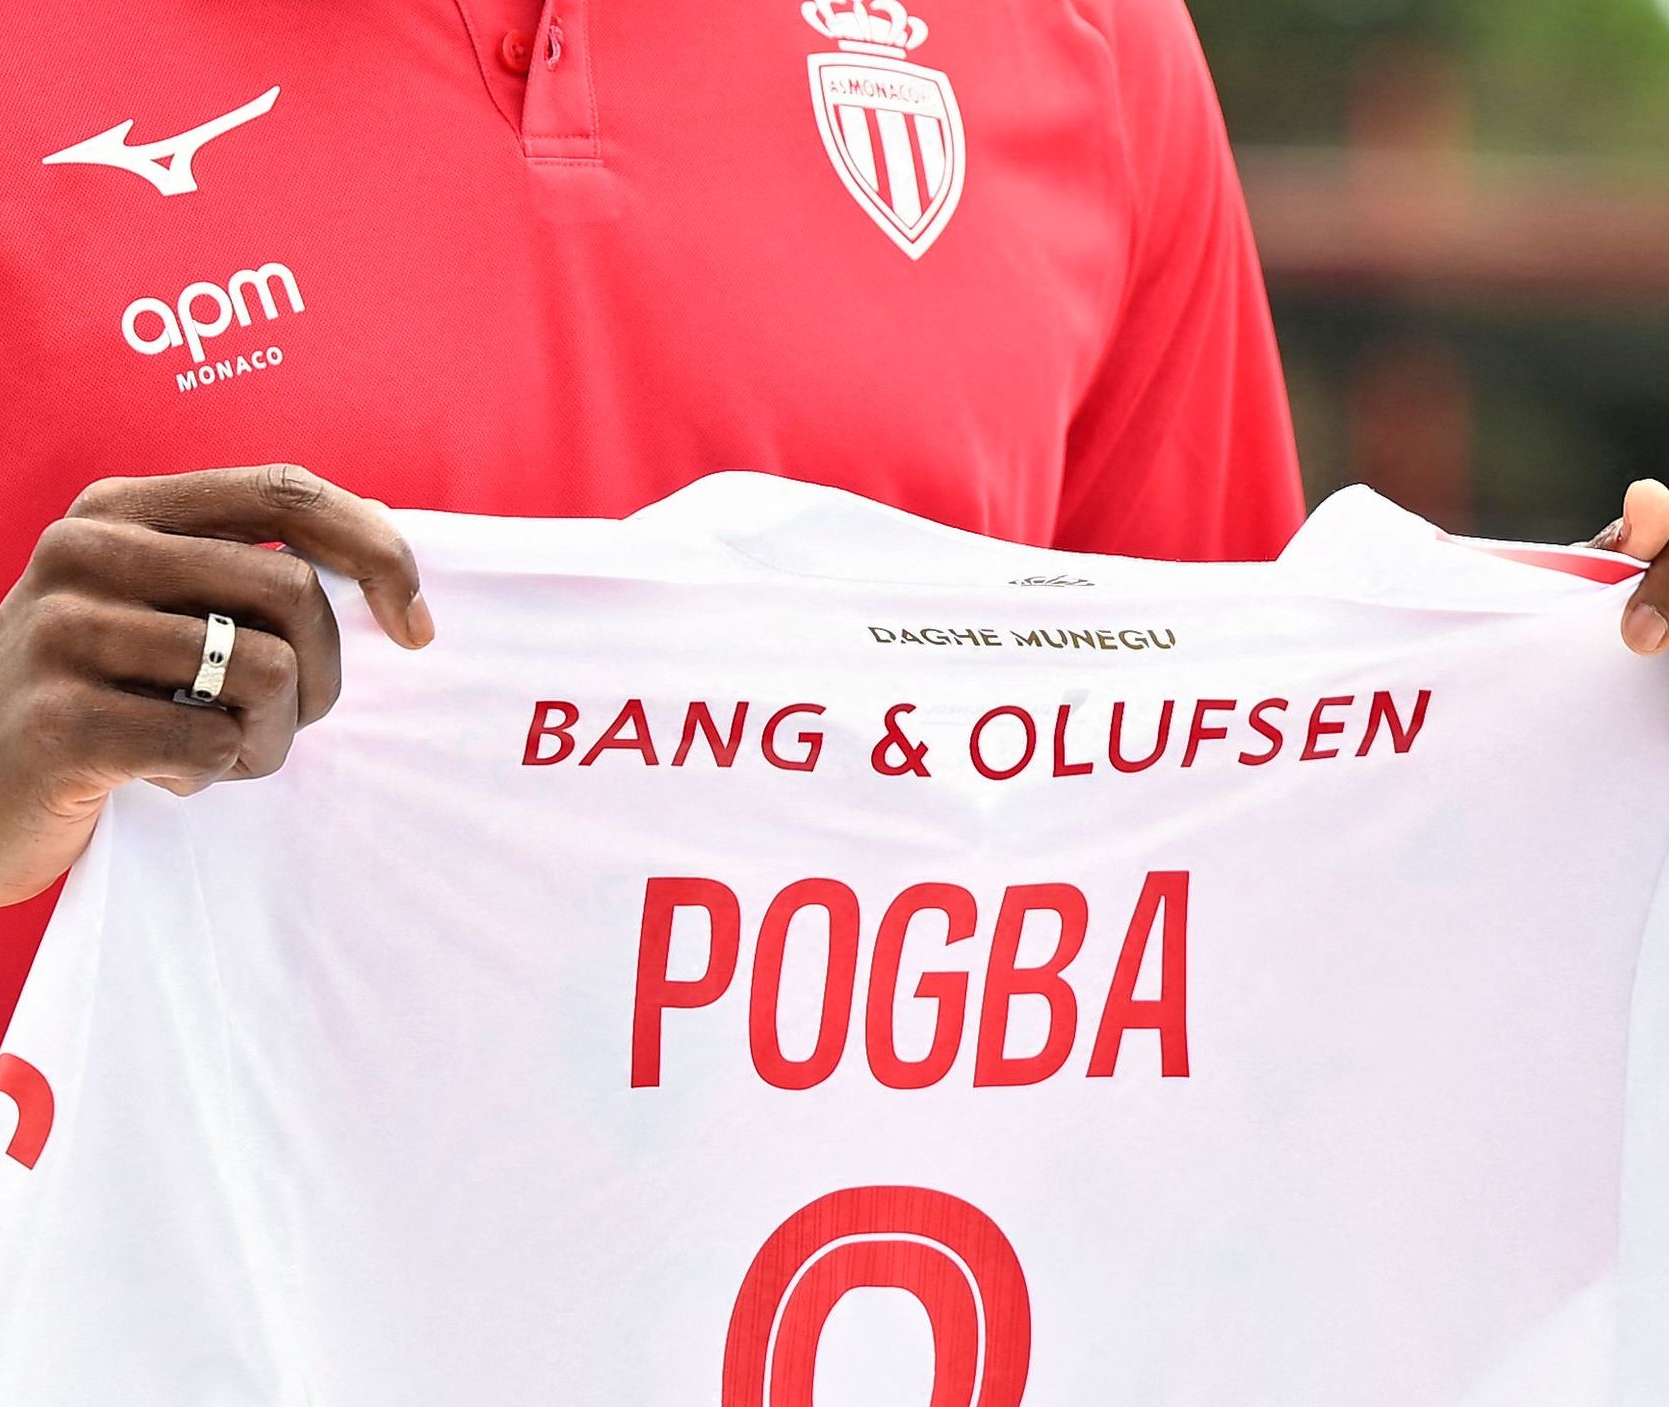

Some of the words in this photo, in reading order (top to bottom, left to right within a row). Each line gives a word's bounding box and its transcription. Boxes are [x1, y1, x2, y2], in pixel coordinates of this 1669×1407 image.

[121, 262, 306, 363] apm
[176, 346, 284, 392] MONACO
[867, 626, 1003, 647] DAGHE
[1009, 628, 1176, 651] MUNEGU
[522, 698, 826, 772] BANG
[871, 703, 931, 778] &
[969, 689, 1432, 782] OLUFSEN
[631, 869, 1190, 1091] POGBA
